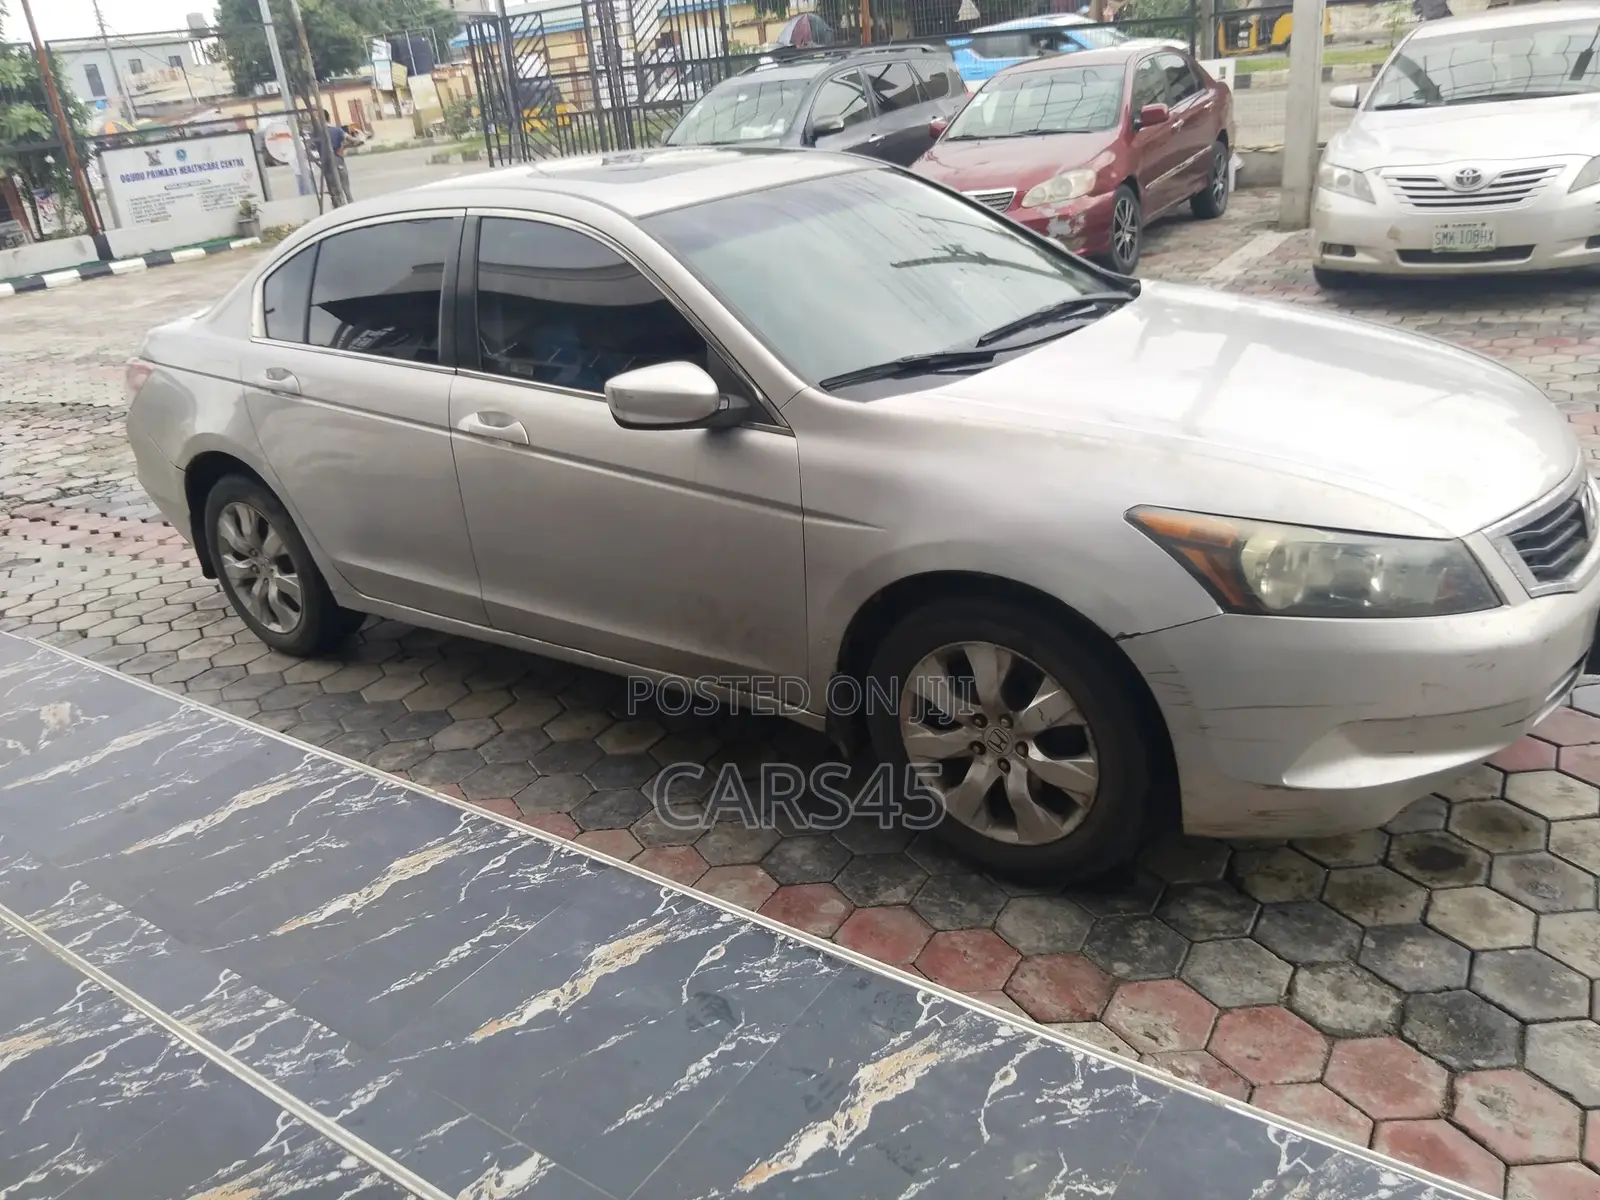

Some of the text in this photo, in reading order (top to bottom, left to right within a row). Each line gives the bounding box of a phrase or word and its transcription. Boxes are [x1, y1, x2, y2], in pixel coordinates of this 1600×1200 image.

[147, 167, 177, 179] PRIMARY
[178, 161, 219, 175] HEALTHCARE
[220, 158, 245, 169] CENTRE
